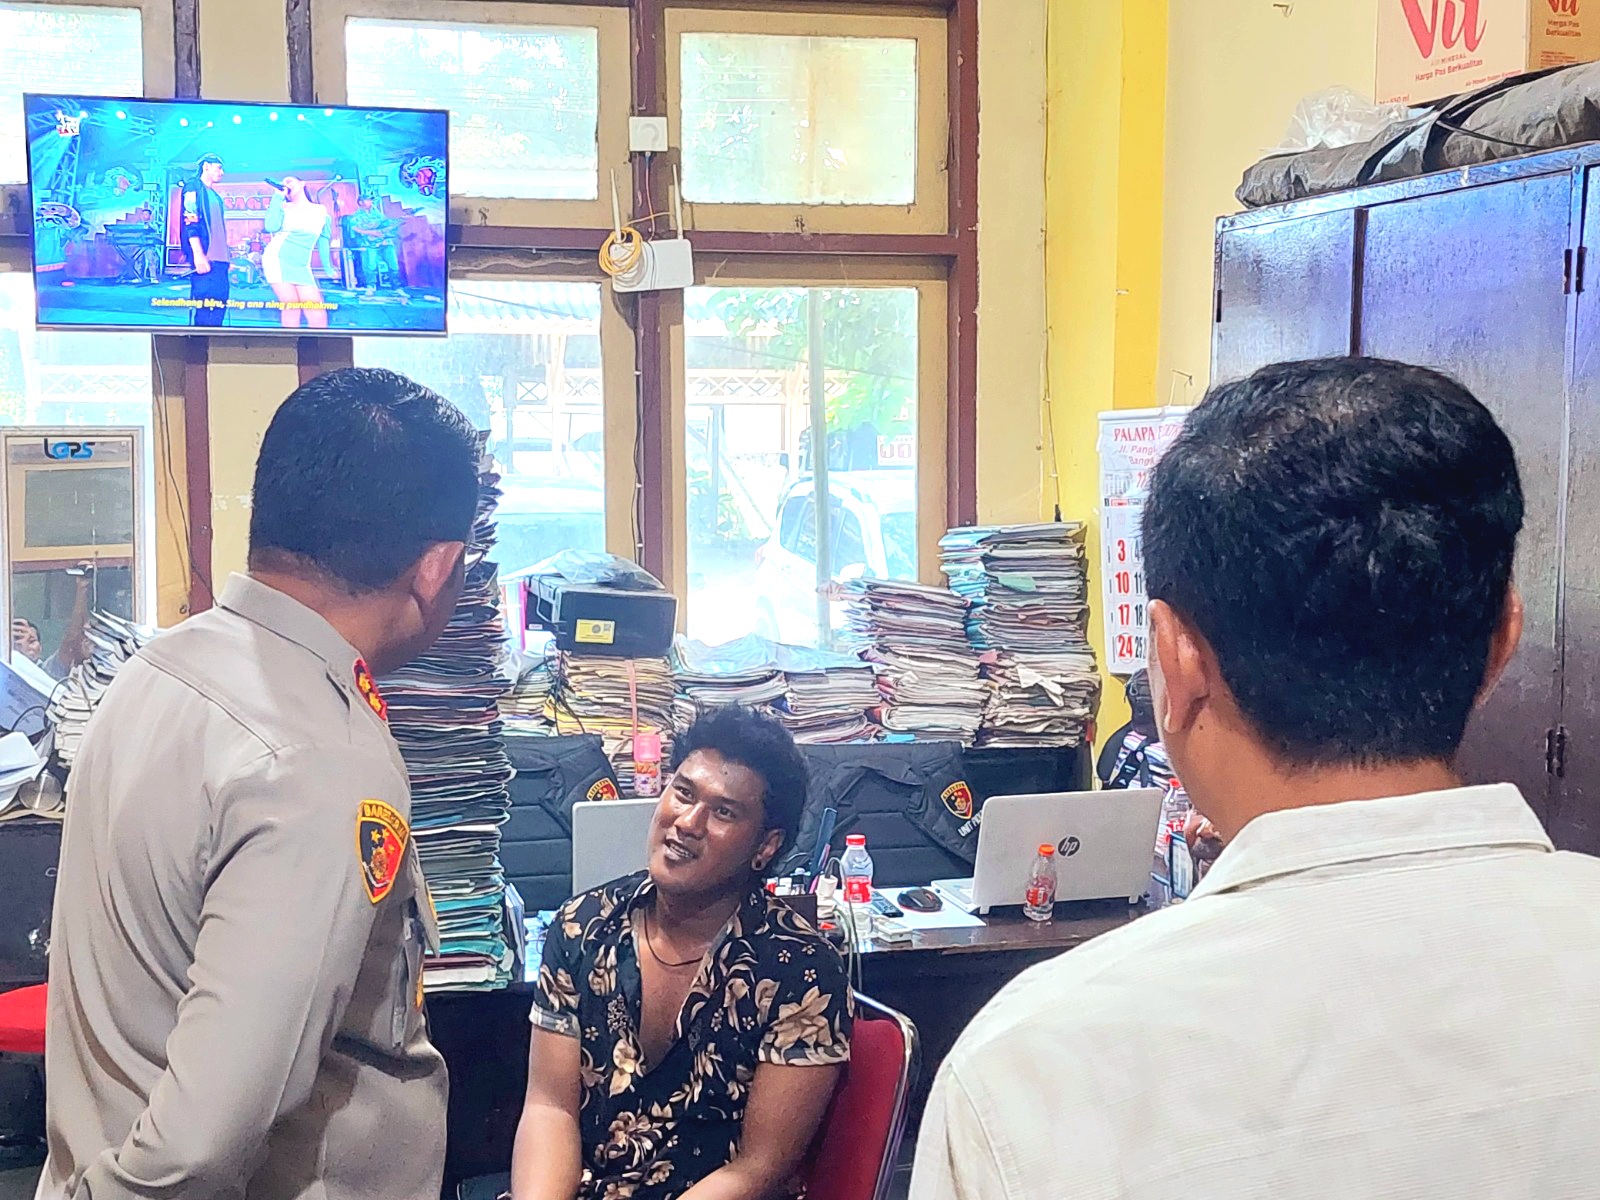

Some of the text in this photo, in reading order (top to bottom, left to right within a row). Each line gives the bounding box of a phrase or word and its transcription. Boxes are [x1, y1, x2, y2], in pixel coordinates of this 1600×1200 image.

[1415, 59, 1484, 82] Harga Pas Berkualitas
[204, 298, 225, 309] biru,
[226, 300, 245, 309] Sing
[265, 301, 285, 310] ning
[1113, 427, 1156, 442] PALAPA
[1118, 539, 1126, 562] 3
[1115, 571, 1143, 594] 10 11
[1118, 604, 1143, 626] 17 18
[1118, 635, 1133, 658] 24
[1060, 835, 1079, 857] hp
